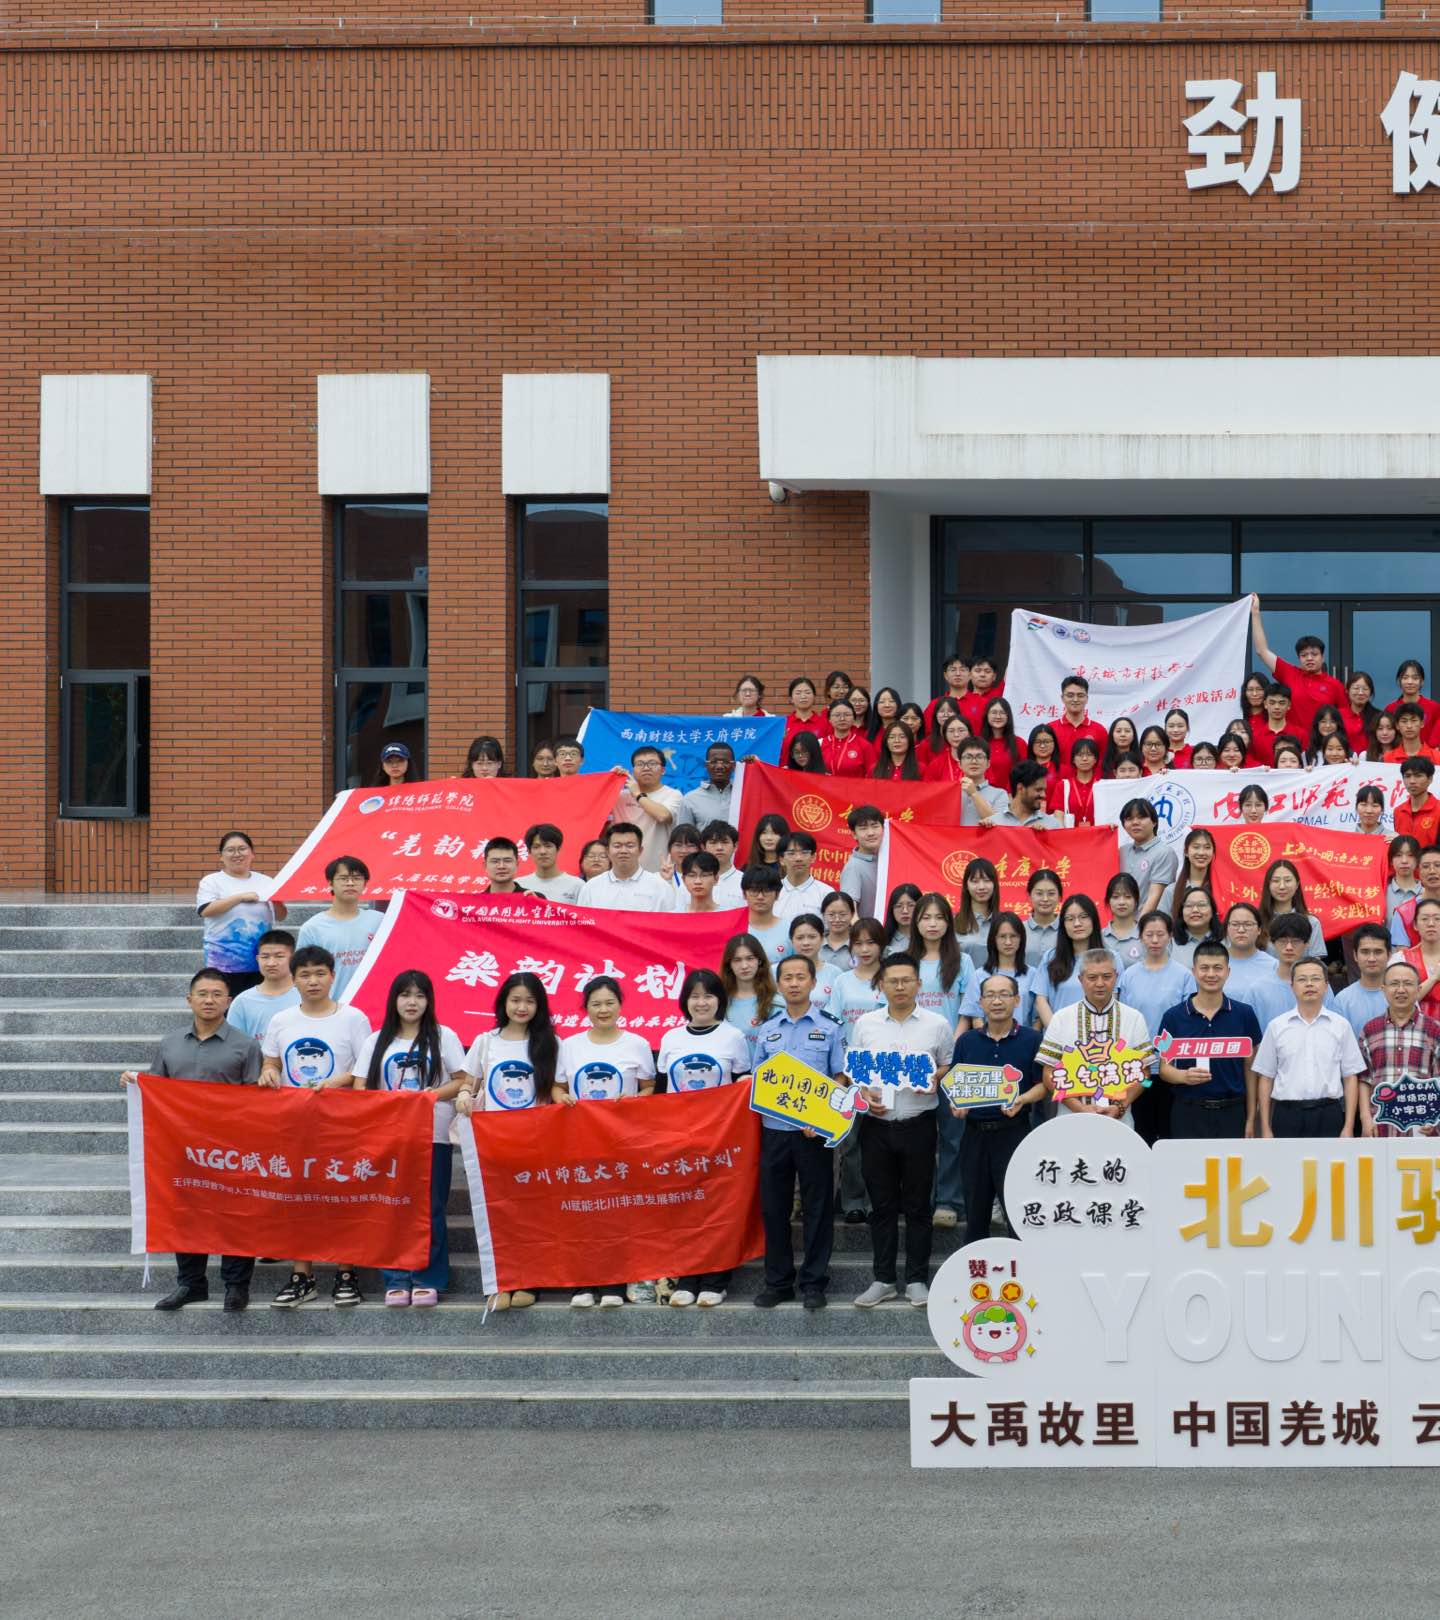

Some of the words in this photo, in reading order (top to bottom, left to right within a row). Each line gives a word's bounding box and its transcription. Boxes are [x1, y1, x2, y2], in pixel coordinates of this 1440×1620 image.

[621, 728, 757, 744] 西南财经大学天府学院
[1176, 1041, 1241, 1056] 北川团团
[1052, 1060, 1145, 1091] 元气满满
[949, 1084, 998, 1098] 未来可期
[1399, 1083, 1435, 1091] BOOM
[776, 1091, 808, 1113] 爱你
[1391, 1105, 1427, 1116] 小宇宙
[1035, 1158, 1129, 1186] 行走的
[1022, 1199, 1148, 1231] 思政课堂
[929, 1400, 1139, 1449] 大禹故里
[1172, 1399, 1381, 1449] 中国羌城
